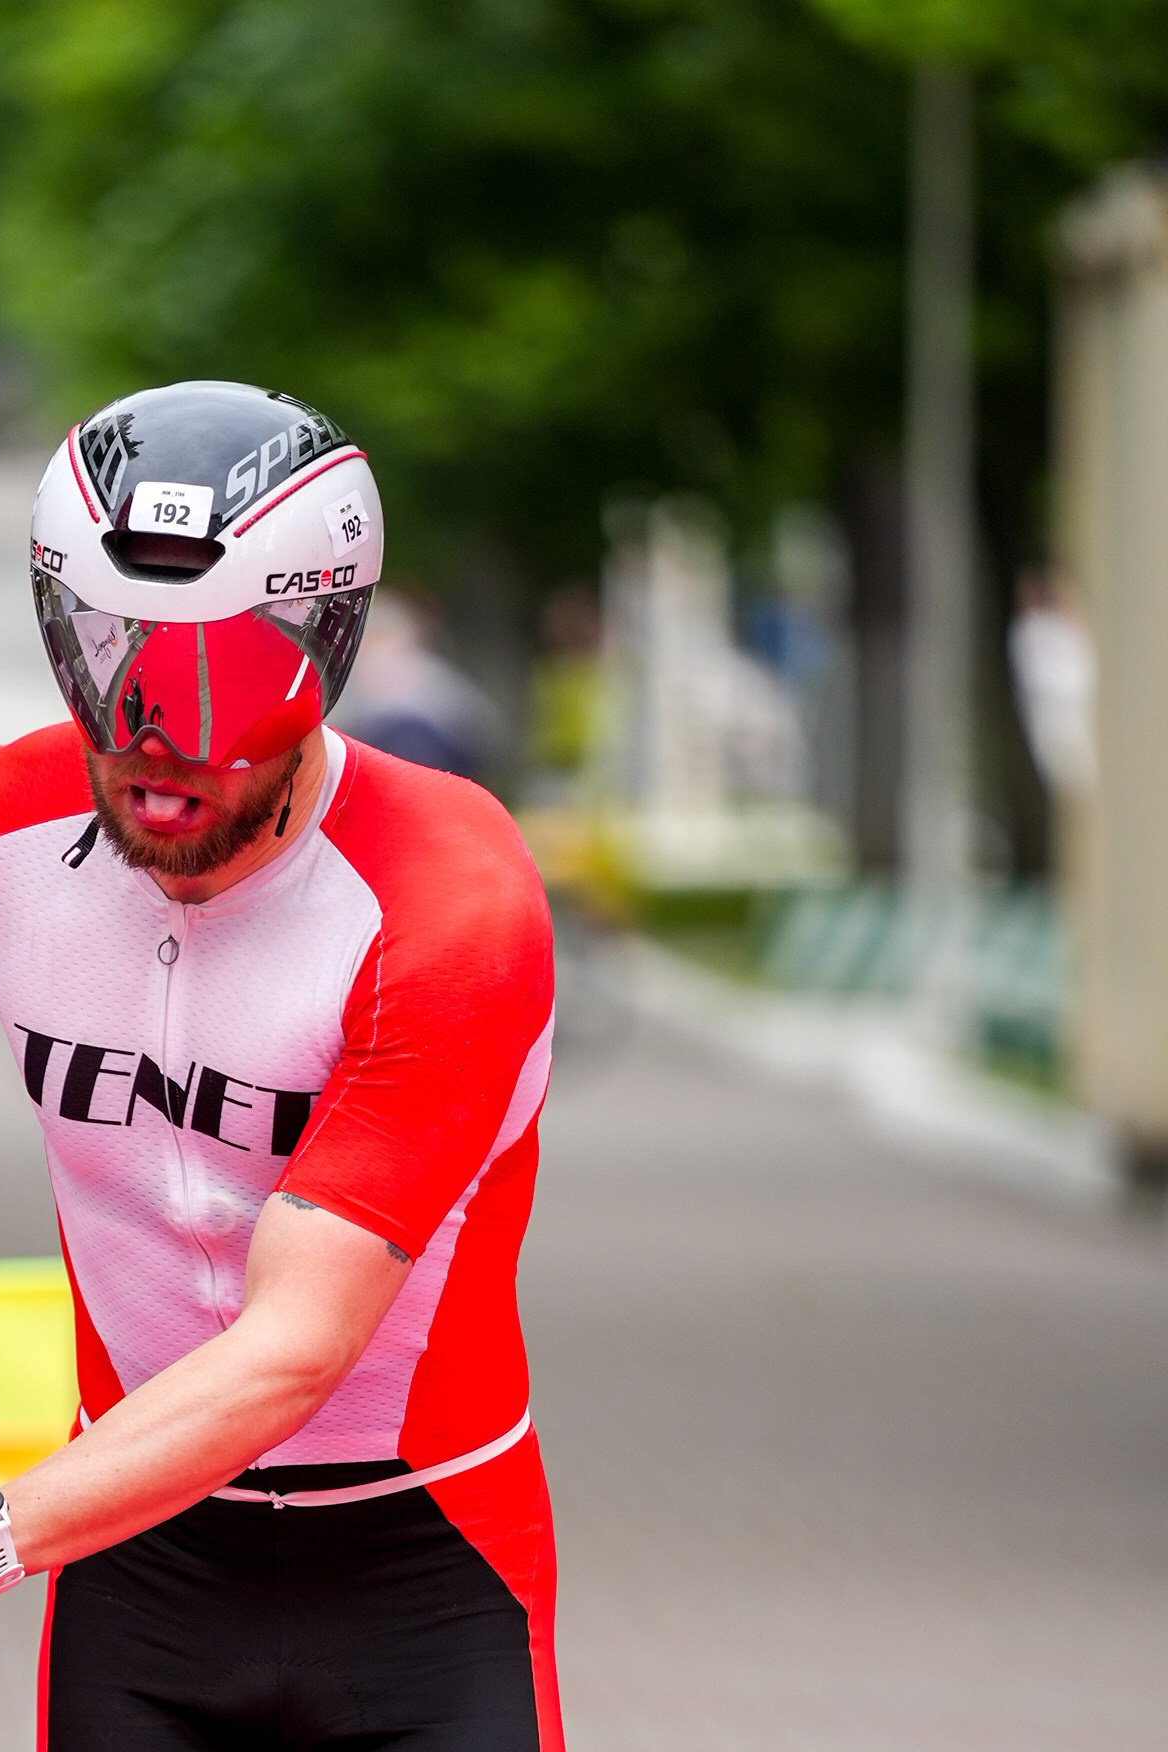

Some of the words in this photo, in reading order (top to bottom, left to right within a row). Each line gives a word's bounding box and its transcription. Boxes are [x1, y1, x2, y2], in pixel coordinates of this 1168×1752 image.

[153, 503, 191, 526] 192
[341, 515, 362, 543] 192
[14, 1023, 321, 1157] TENET
